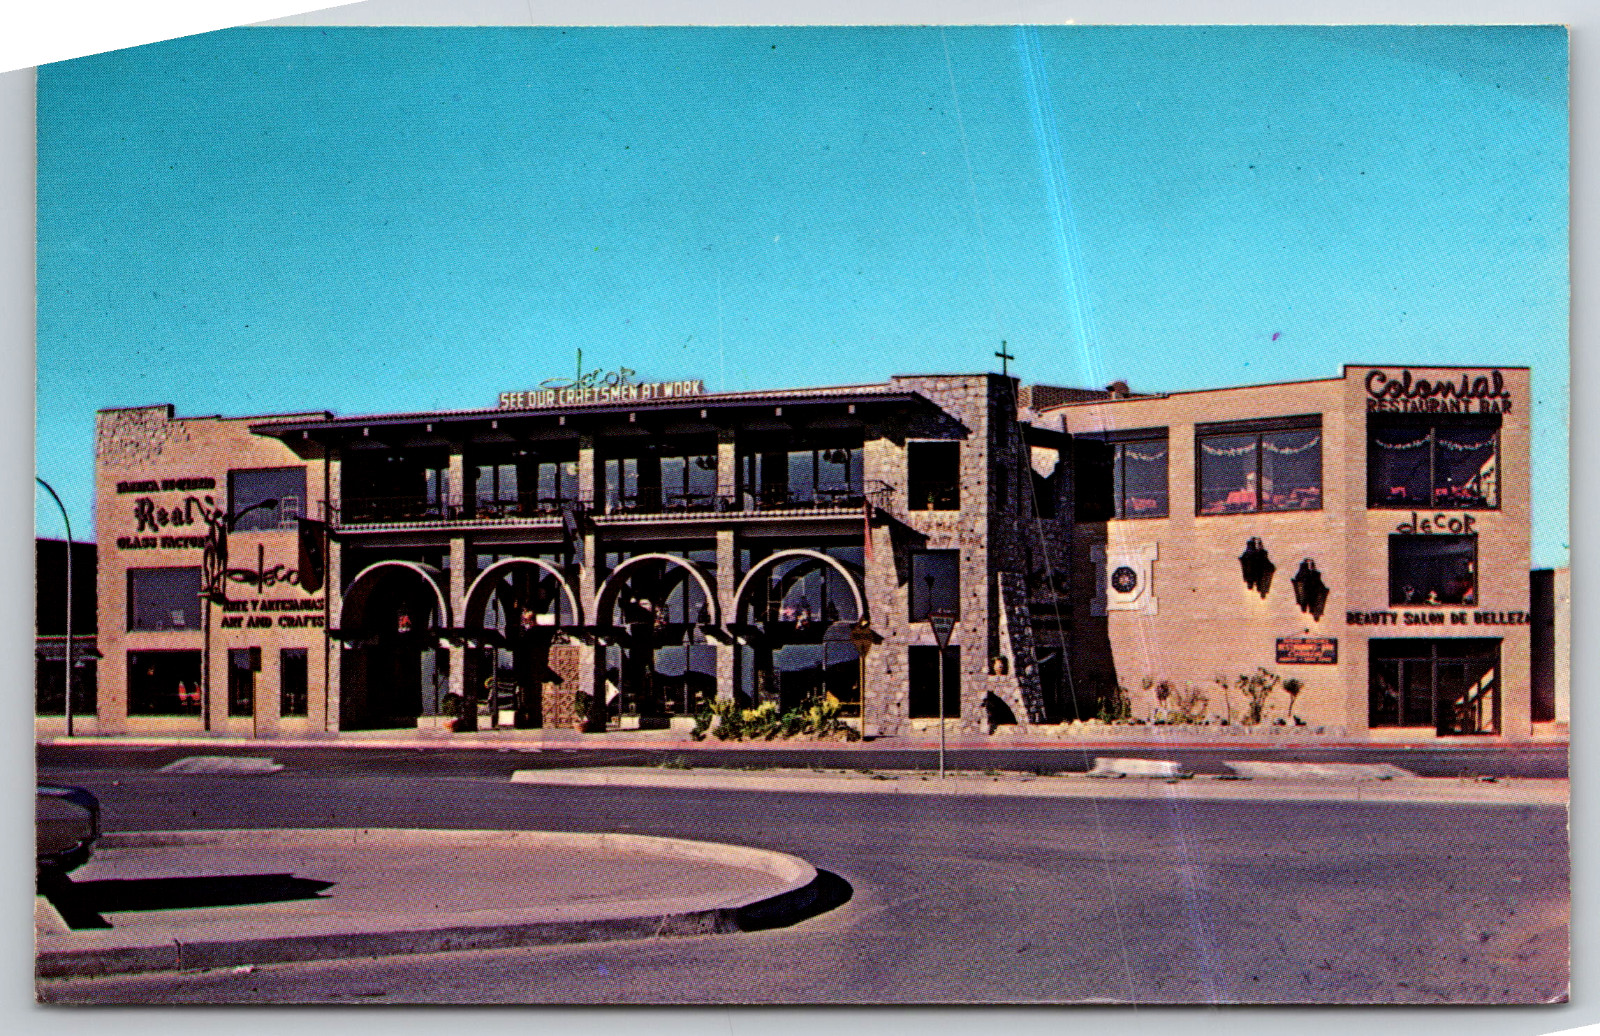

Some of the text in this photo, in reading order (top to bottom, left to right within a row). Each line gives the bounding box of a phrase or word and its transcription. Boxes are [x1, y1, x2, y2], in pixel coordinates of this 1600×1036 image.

[1365, 369, 1511, 399] Colonial
[500, 380, 702, 410] SEE OUR CRAFTSMEN AT WORK
[1366, 398, 1513, 414] RESTAURANT BAR
[134, 496, 194, 532] Real
[116, 536, 157, 549] GLASS
[250, 600, 259, 611] Y
[221, 615, 325, 628] ART AND CRAFTS
[1346, 611, 1531, 625] BEAUTY SALON DE BELLEZA
